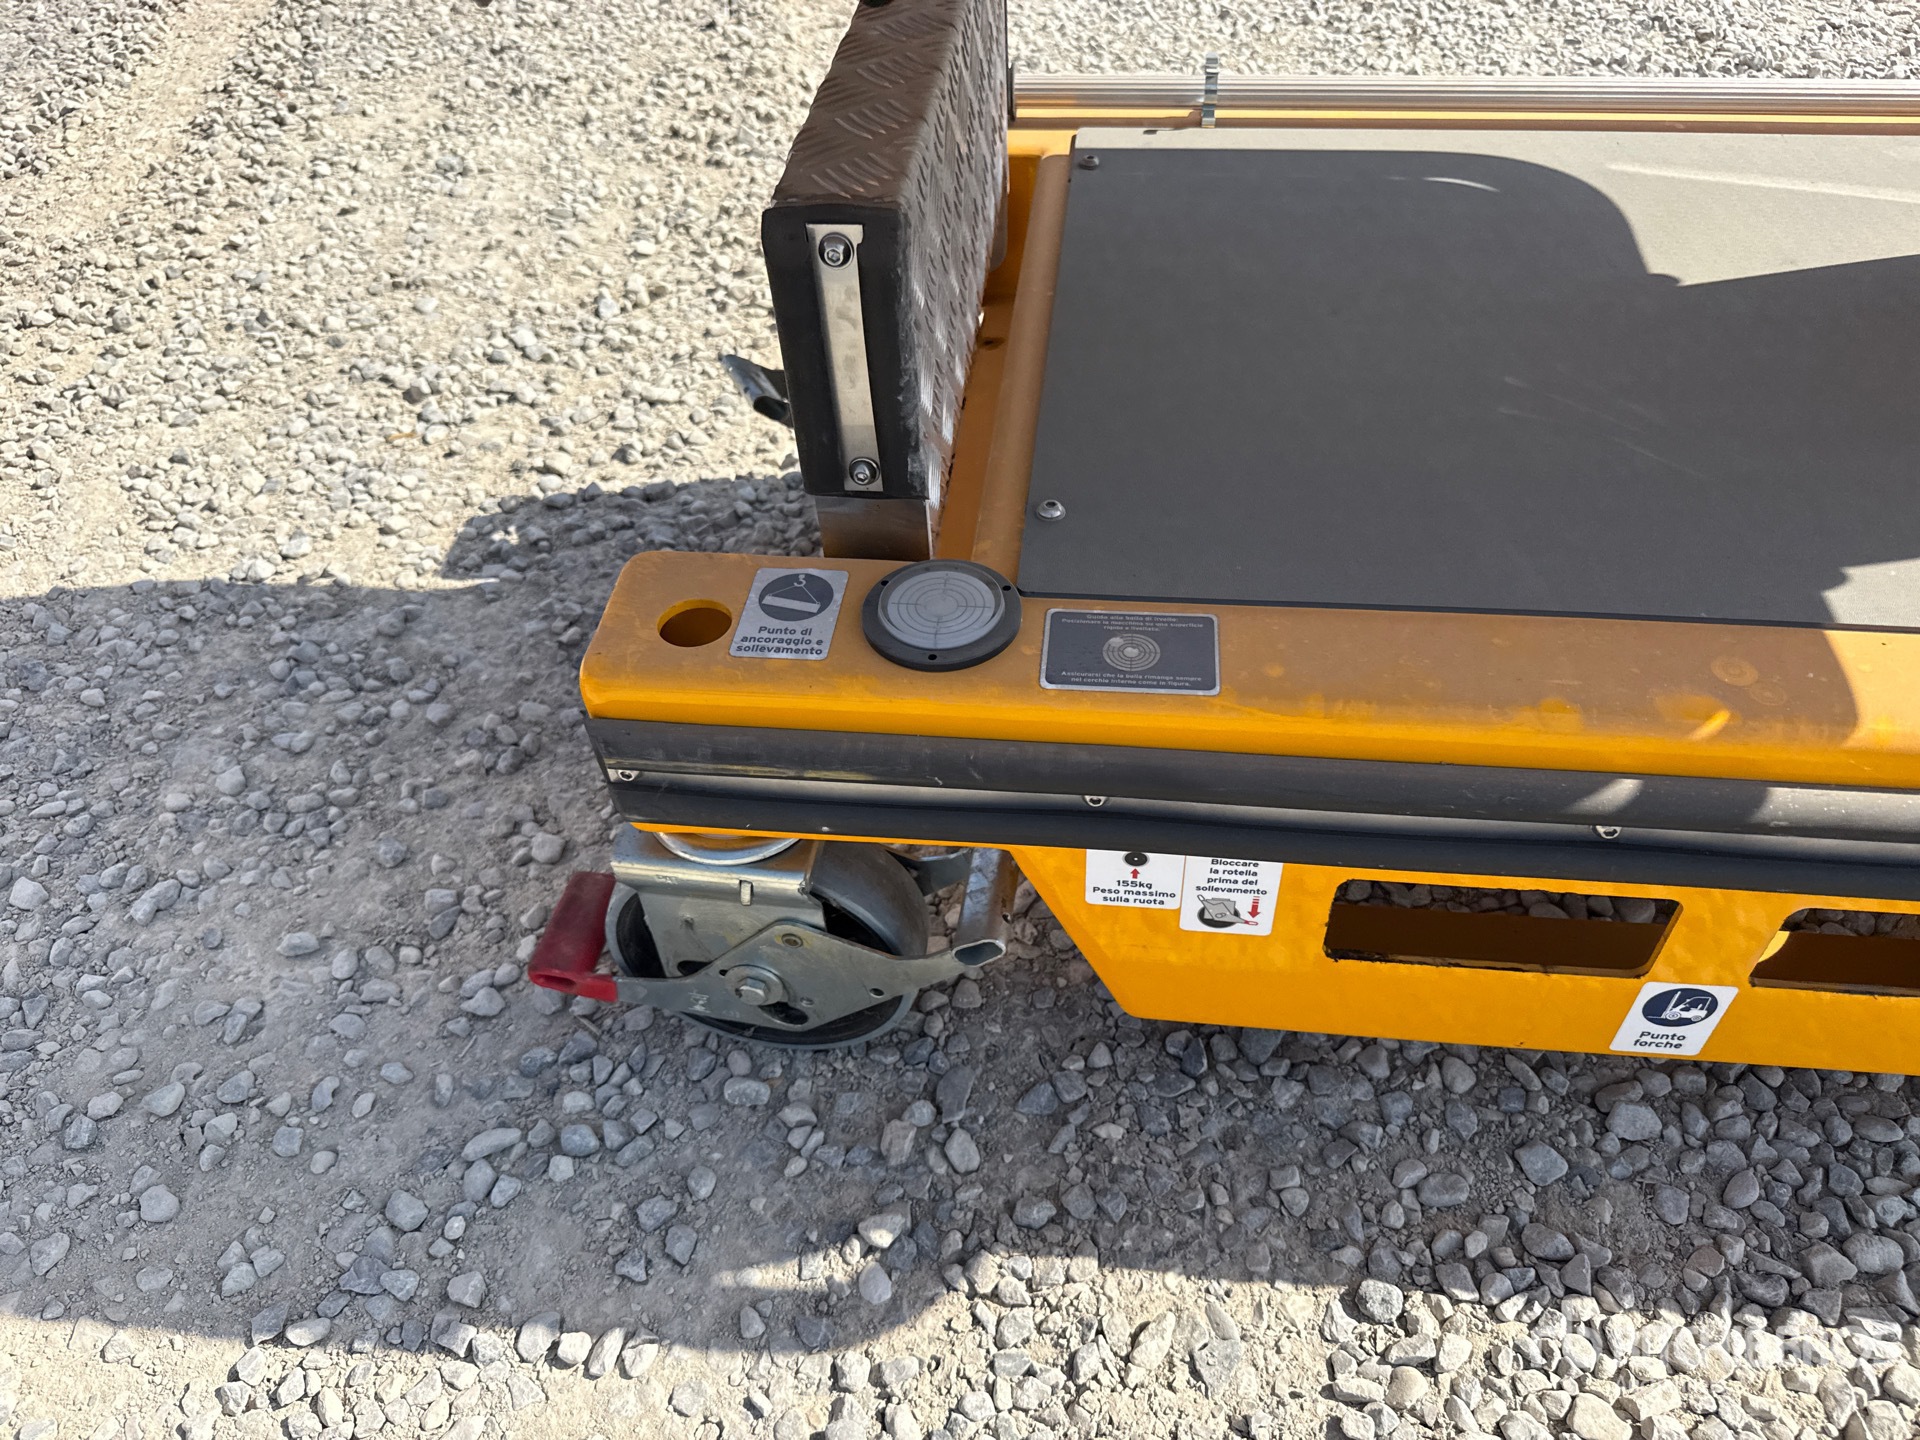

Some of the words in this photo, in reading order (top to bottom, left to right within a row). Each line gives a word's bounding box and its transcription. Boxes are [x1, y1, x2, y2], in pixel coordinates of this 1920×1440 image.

[758, 626, 796, 635] Punto
[801, 628, 812, 636] di
[741, 636, 812, 646] ancoraggio
[736, 645, 823, 655] sollevamento
[1211, 859, 1259, 867] Bloccare
[1222, 868, 1258, 876] rotella
[1116, 880, 1152, 890] 155kg
[1195, 885, 1267, 895] sollevamento
[1093, 886, 1120, 894] Peso
[1124, 889, 1176, 898] massimo
[1133, 897, 1165, 905] ruota
[1639, 1031, 1686, 1041] Punto
[1633, 1039, 1683, 1049] forche
